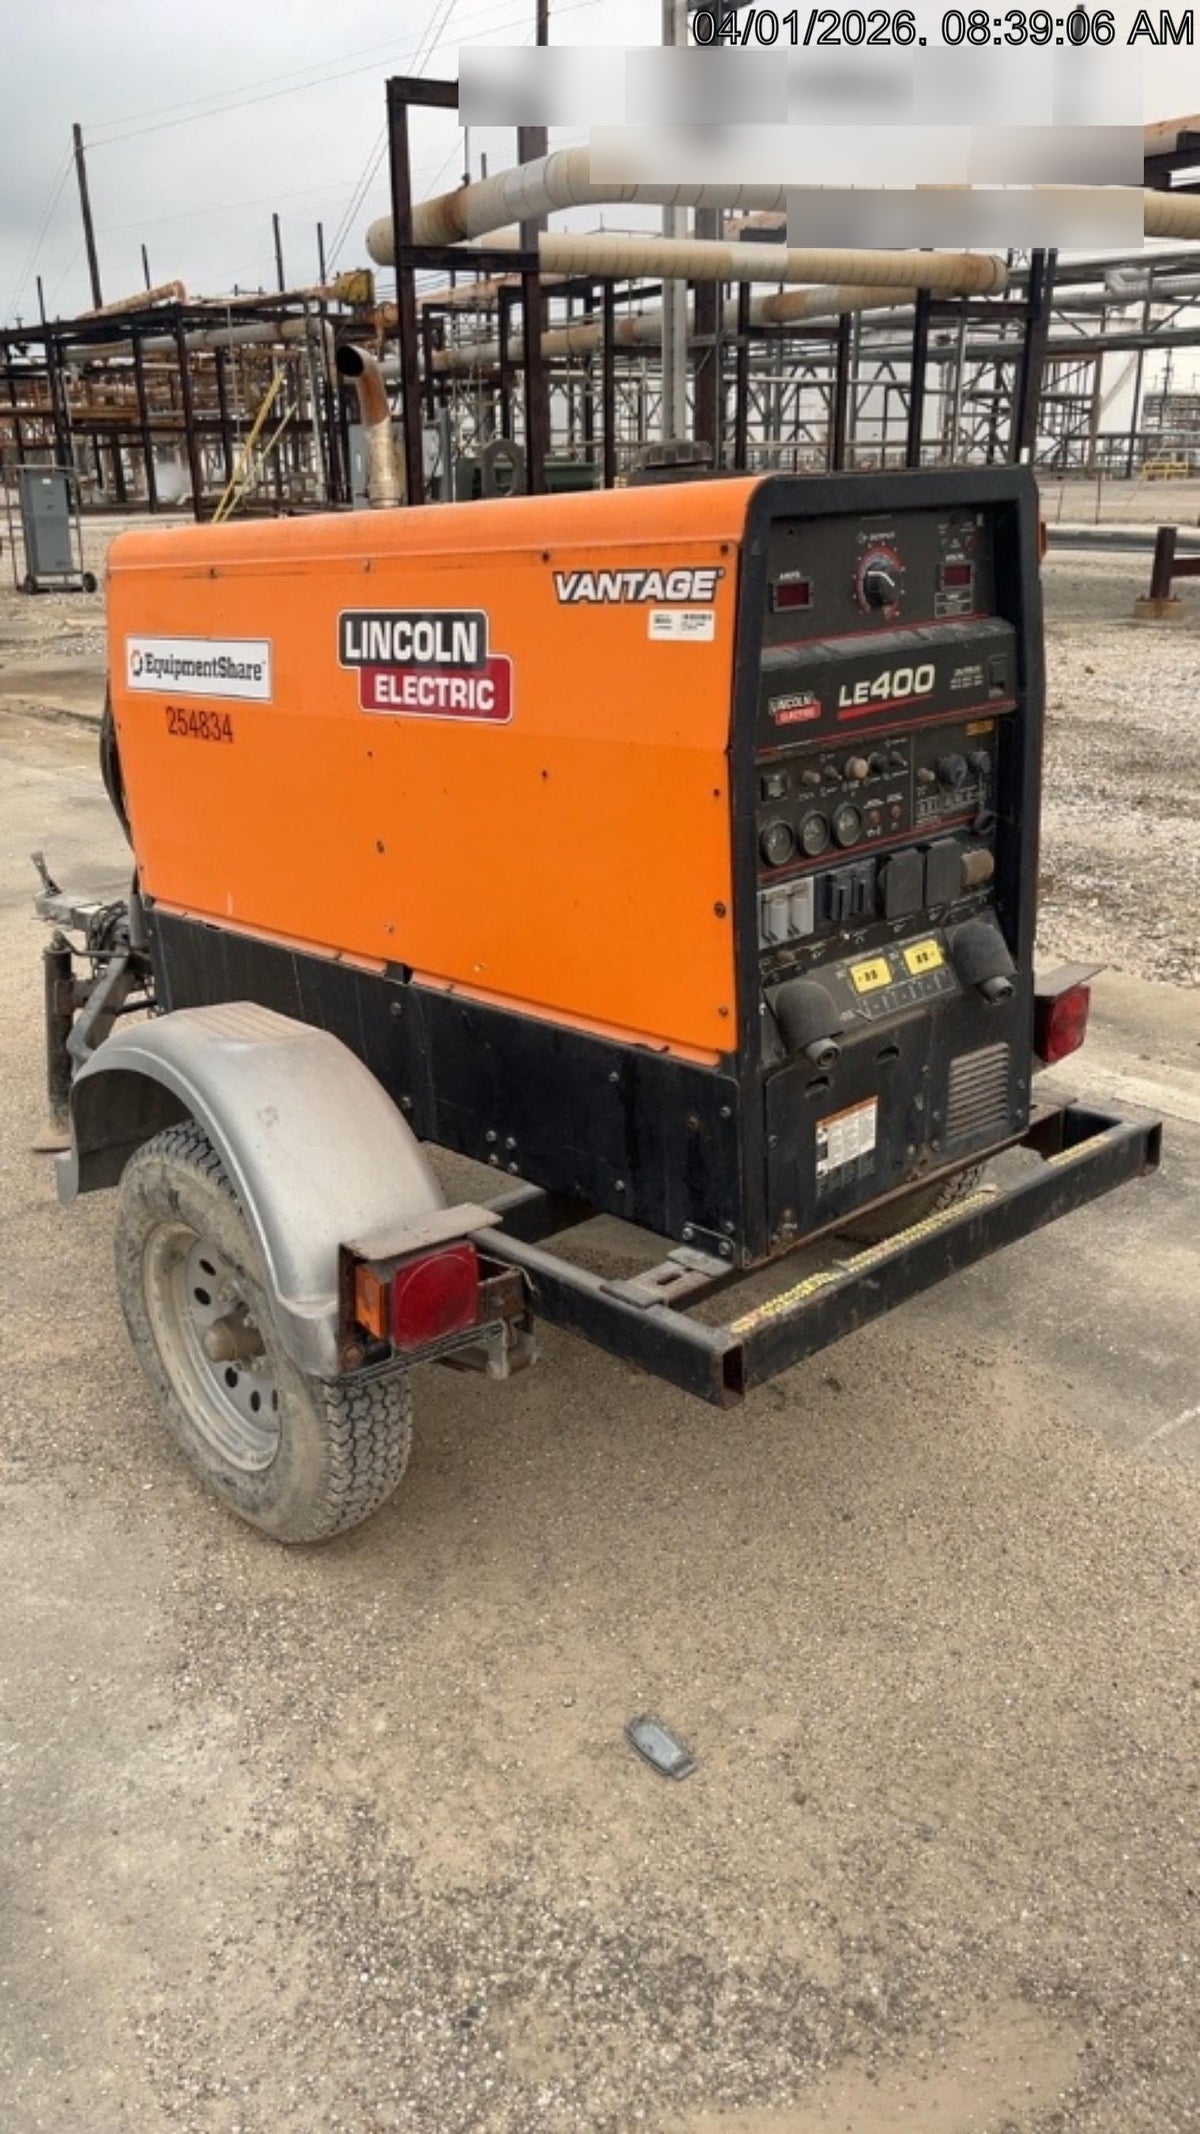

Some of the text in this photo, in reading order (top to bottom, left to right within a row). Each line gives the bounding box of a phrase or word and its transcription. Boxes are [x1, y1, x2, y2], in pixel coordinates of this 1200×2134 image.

[344, 619, 478, 663] LINCOLN
[144, 651, 264, 681] EquipmentShare
[838, 663, 936, 708] LE400
[374, 672, 495, 711] ELECTRIC
[165, 705, 234, 743] 254834
